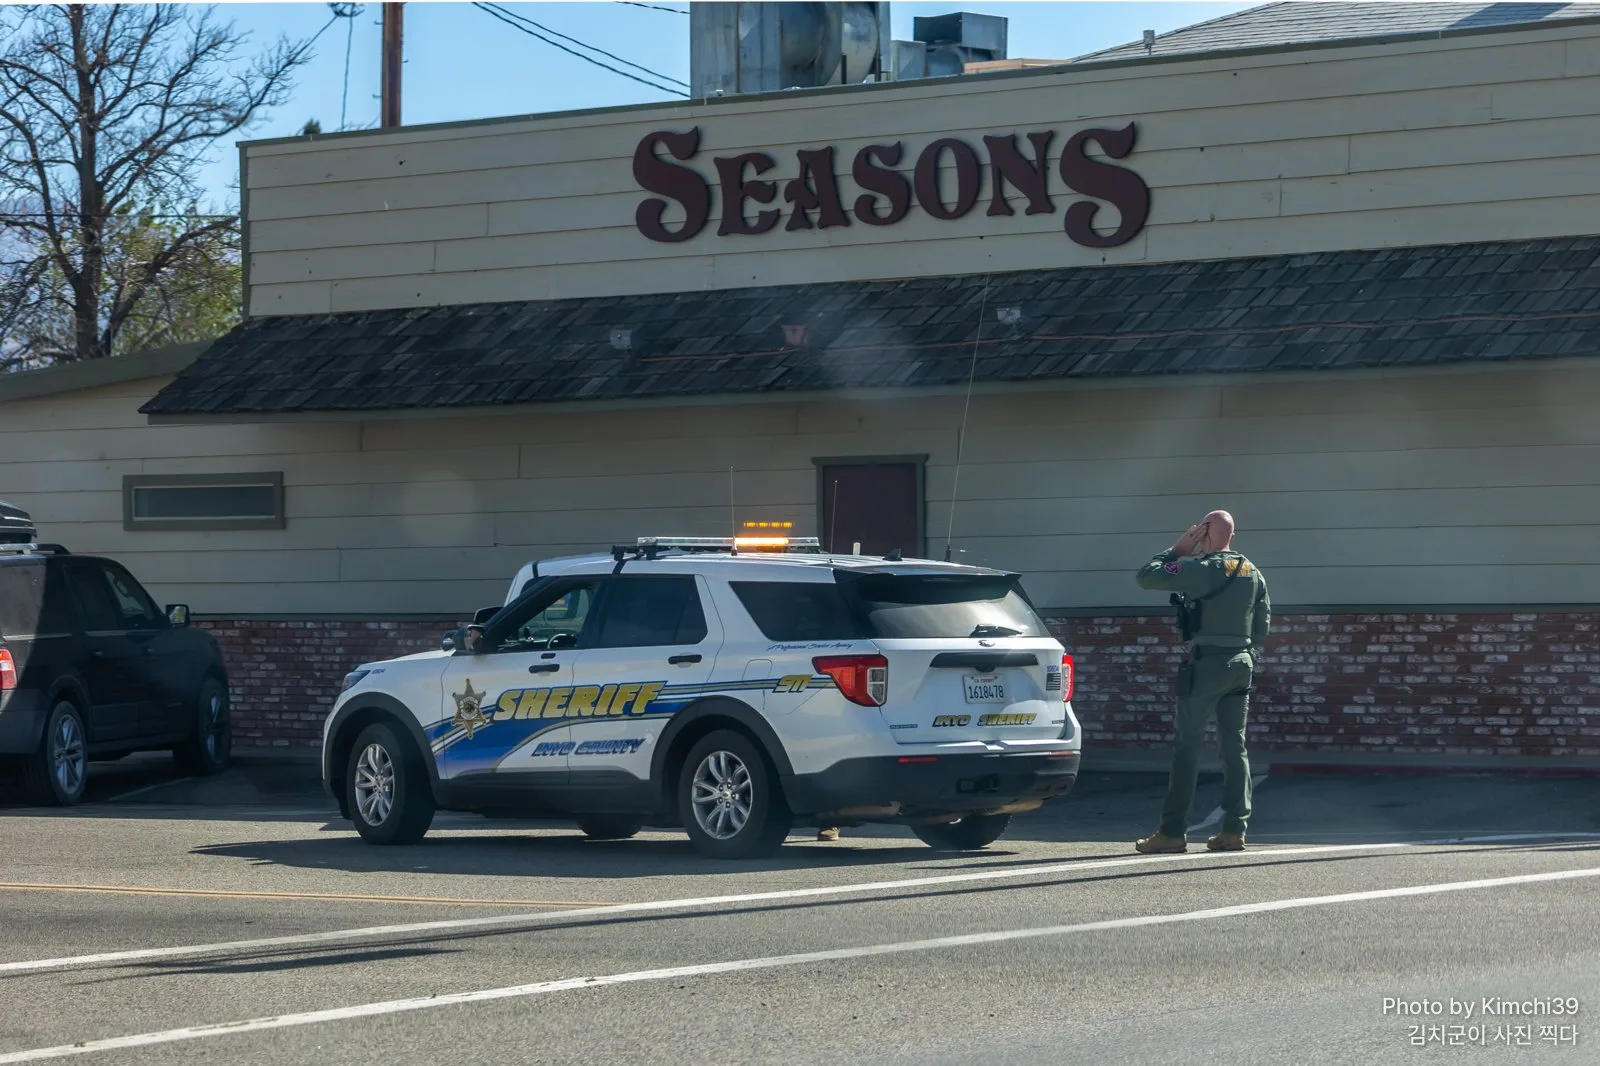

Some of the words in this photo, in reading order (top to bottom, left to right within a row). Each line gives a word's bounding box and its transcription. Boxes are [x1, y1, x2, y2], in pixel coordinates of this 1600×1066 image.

[632, 120, 1151, 248] SEASONS
[490, 680, 668, 721] SHERIFF
[968, 685, 1005, 699] 1618478
[932, 714, 971, 728] INYO
[977, 713, 1037, 727] SHERIFF
[531, 741, 575, 757] INYO
[575, 738, 646, 756] COUNTY
